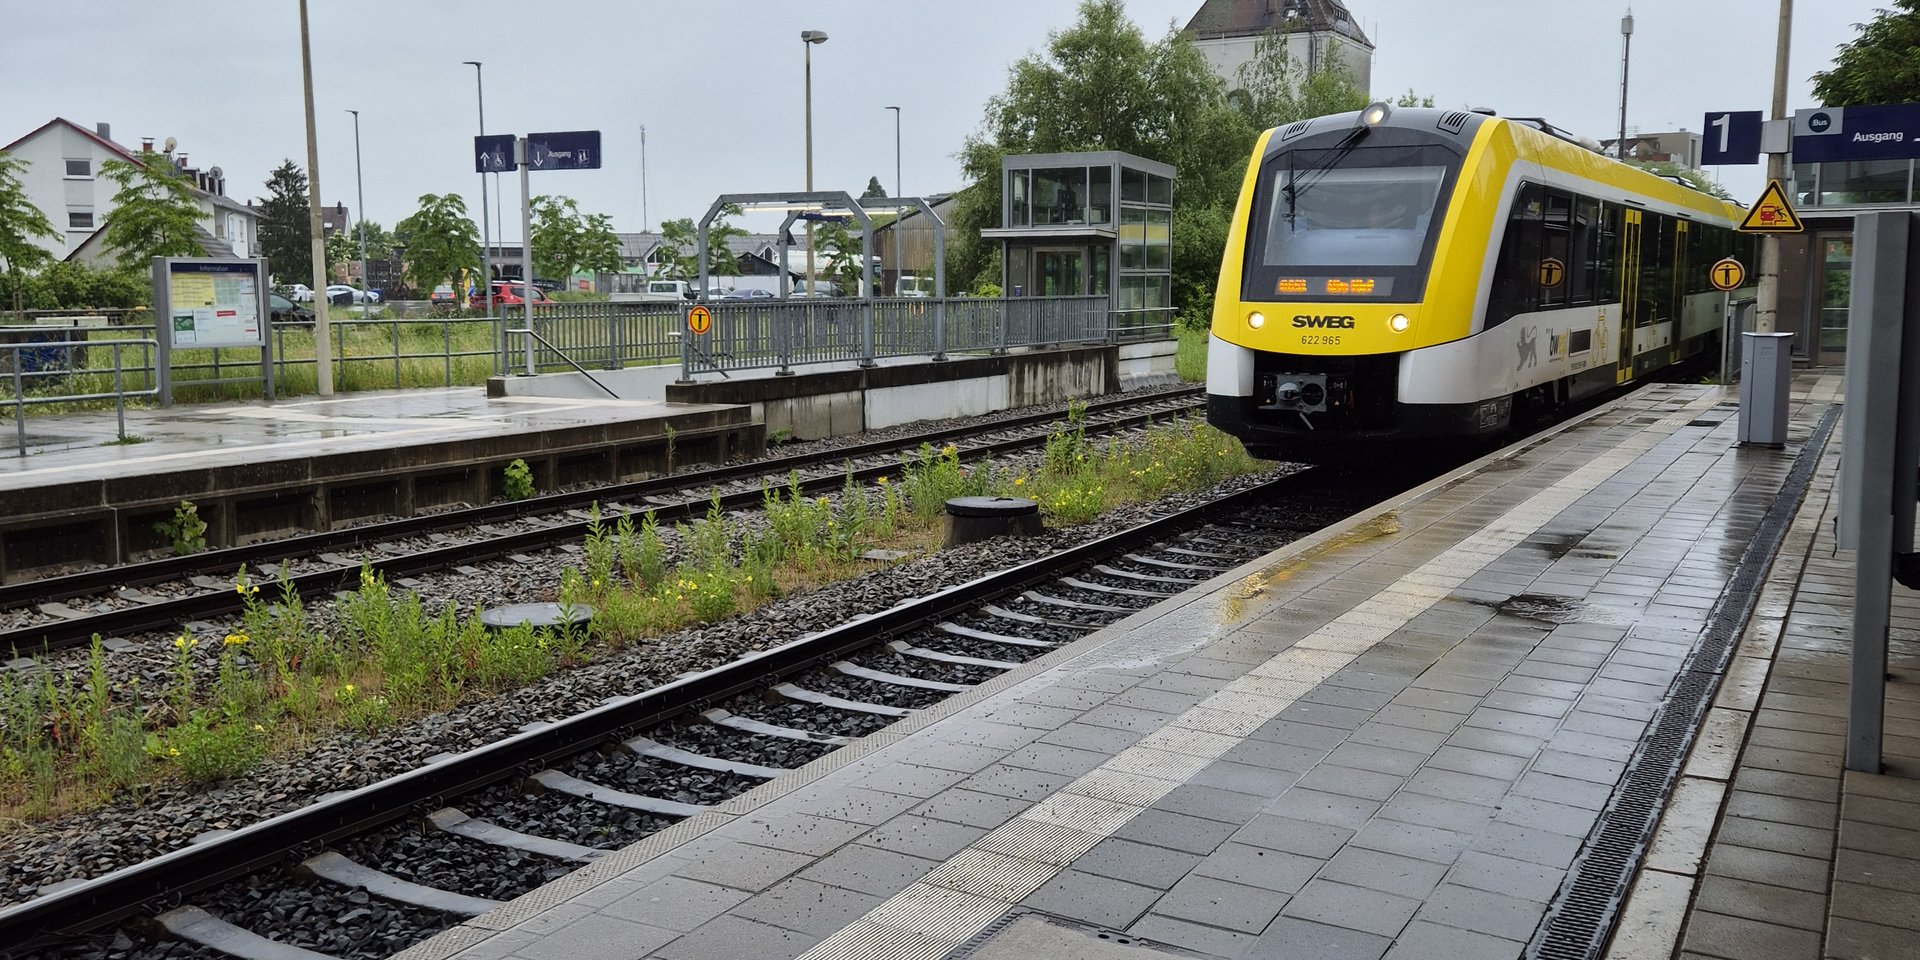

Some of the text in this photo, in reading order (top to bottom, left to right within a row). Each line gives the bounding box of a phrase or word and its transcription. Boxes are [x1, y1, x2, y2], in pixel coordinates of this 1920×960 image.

[1812, 118, 1828, 127] Bus
[1712, 113, 1731, 153] 1
[1852, 131, 1904, 143] Ausgang
[548, 150, 572, 159] Ausgang
[1292, 315, 1355, 329] SWEG
[1301, 335, 1341, 345] 622 965
